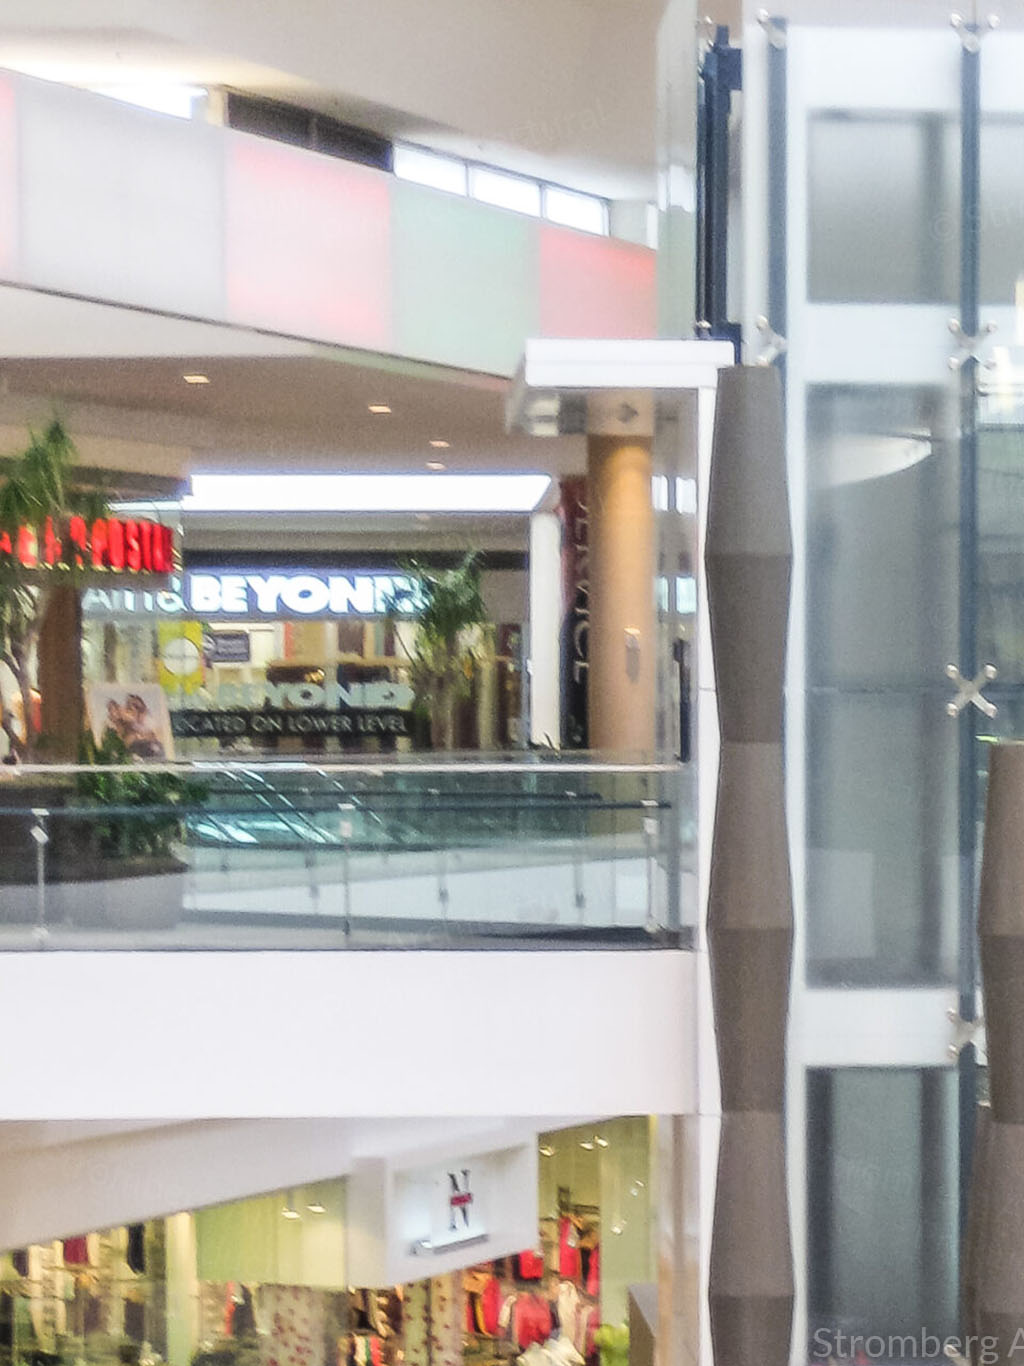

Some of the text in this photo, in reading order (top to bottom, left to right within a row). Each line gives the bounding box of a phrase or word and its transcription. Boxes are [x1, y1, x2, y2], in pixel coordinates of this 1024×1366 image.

[190, 574, 431, 614] BEYOND
[251, 714, 284, 733] ON
[288, 714, 353, 733] LOWER
[357, 714, 408, 733] LEVEL
